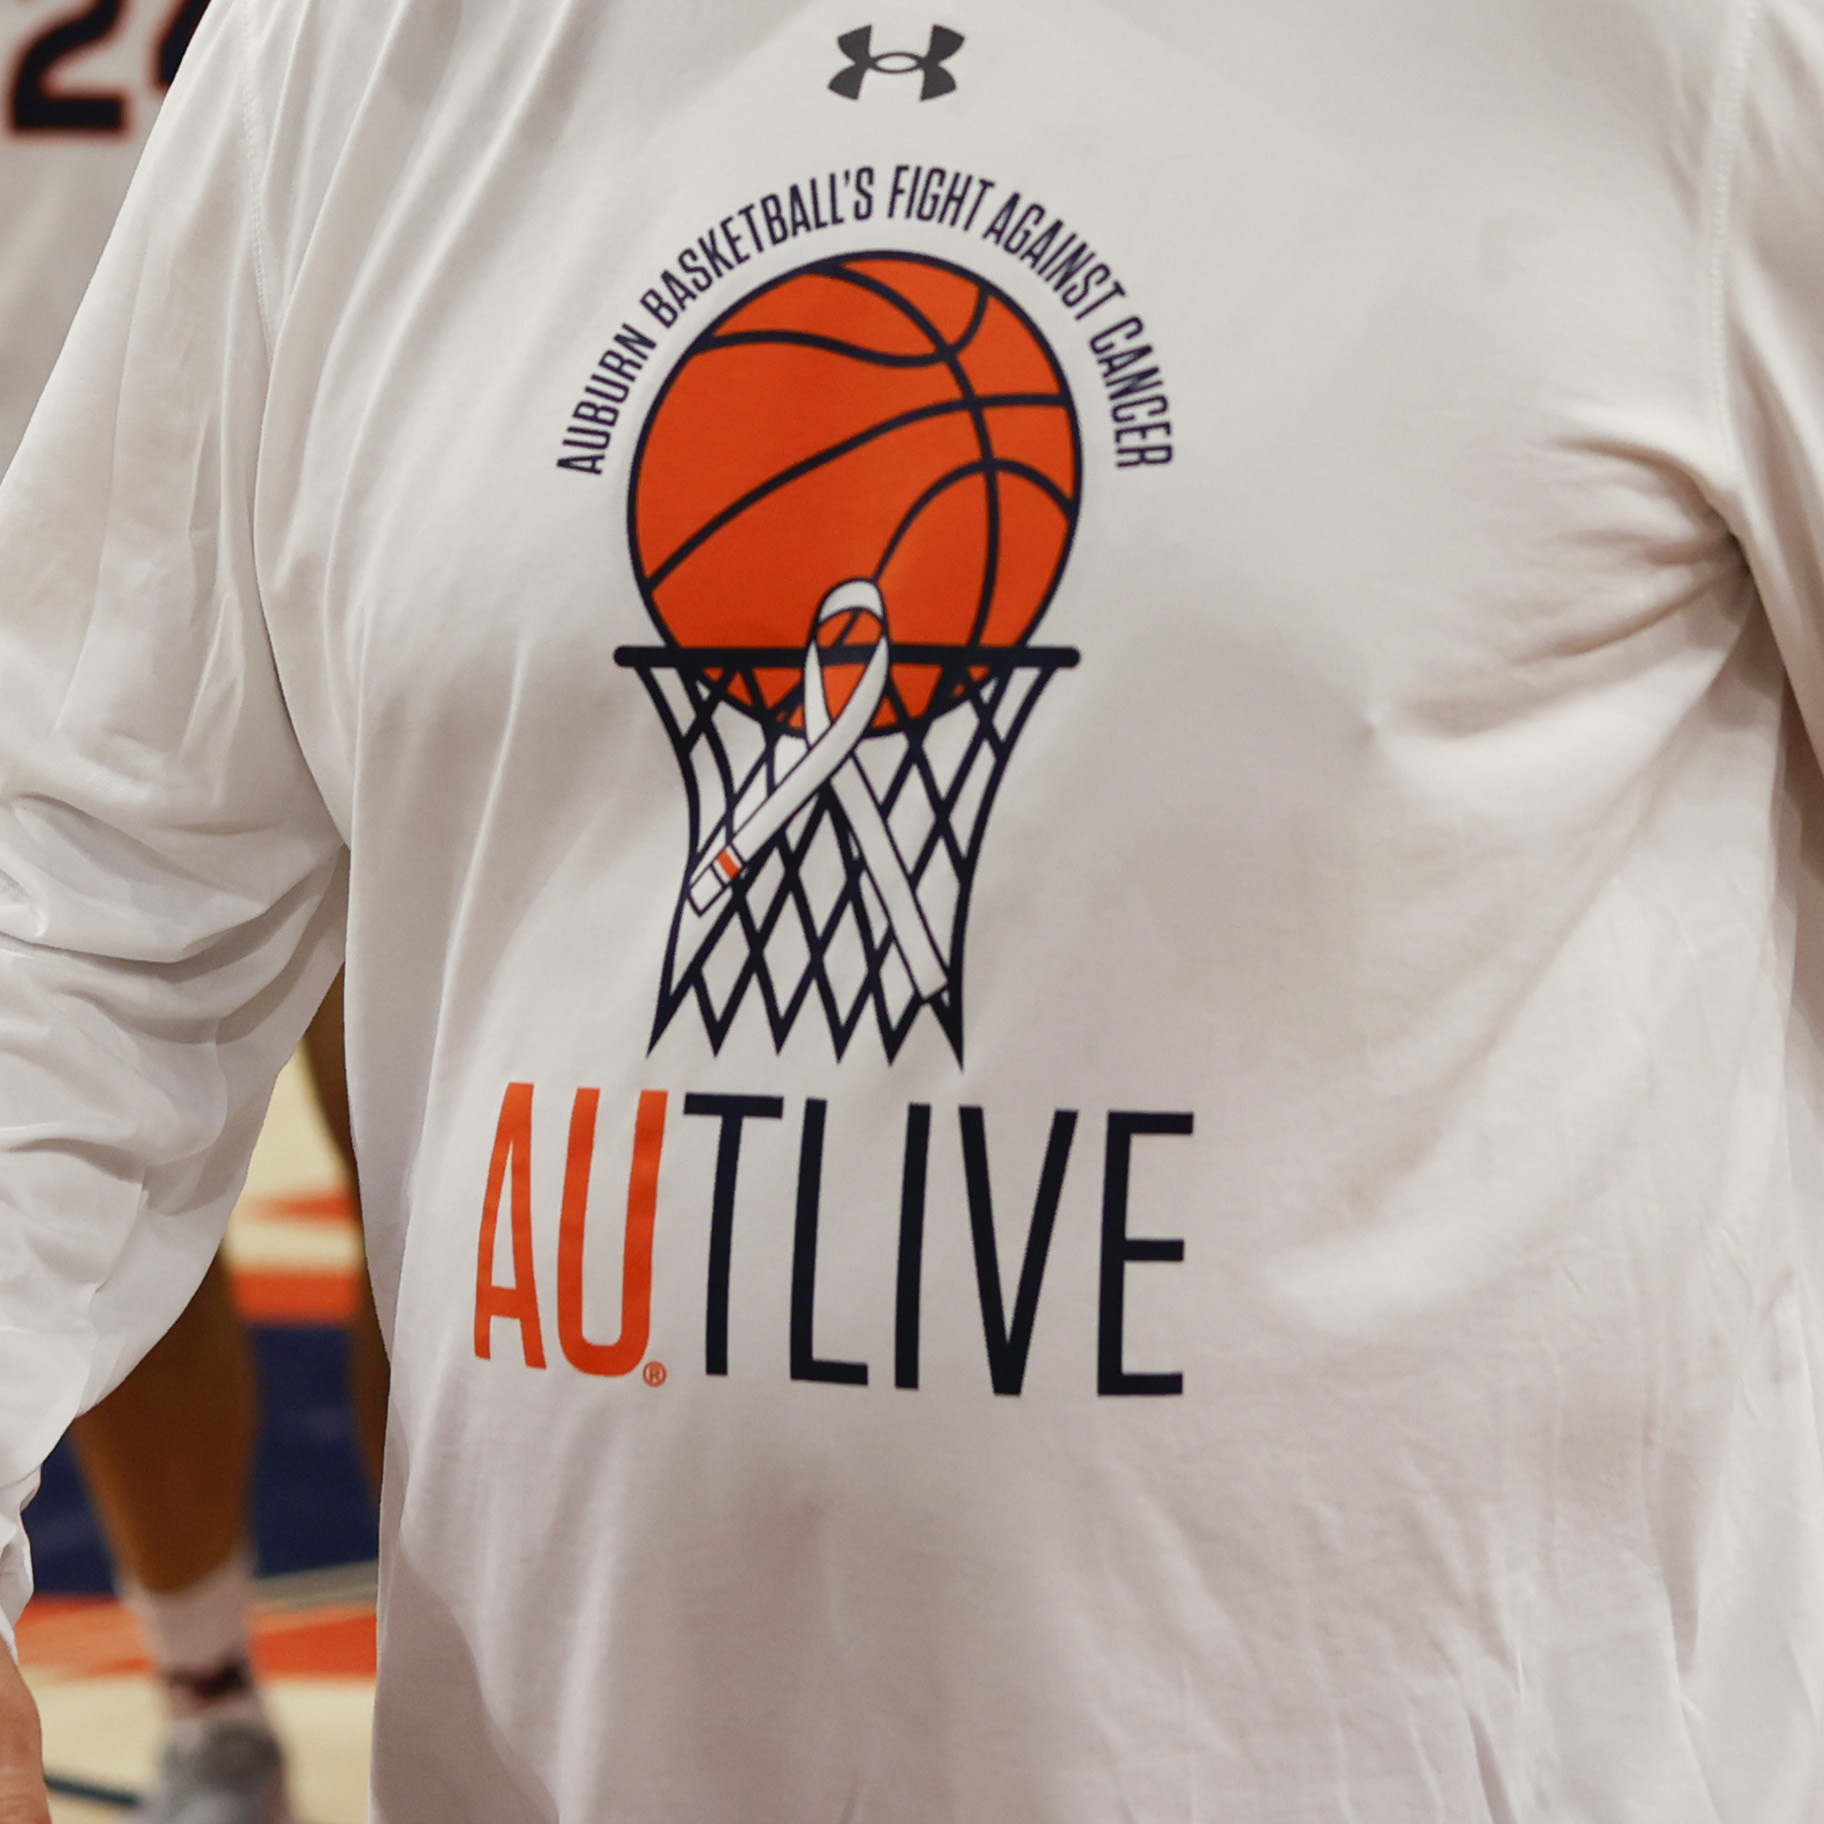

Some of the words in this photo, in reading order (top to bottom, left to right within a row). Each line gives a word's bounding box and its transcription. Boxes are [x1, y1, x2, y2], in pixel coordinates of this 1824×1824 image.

[556, 322, 657, 475] AUBURN
[640, 166, 875, 329] BASKETBALL'S
[887, 164, 996, 232] FIGHT
[982, 192, 1127, 322] AGAINST
[1089, 314, 1173, 469] CANCER
